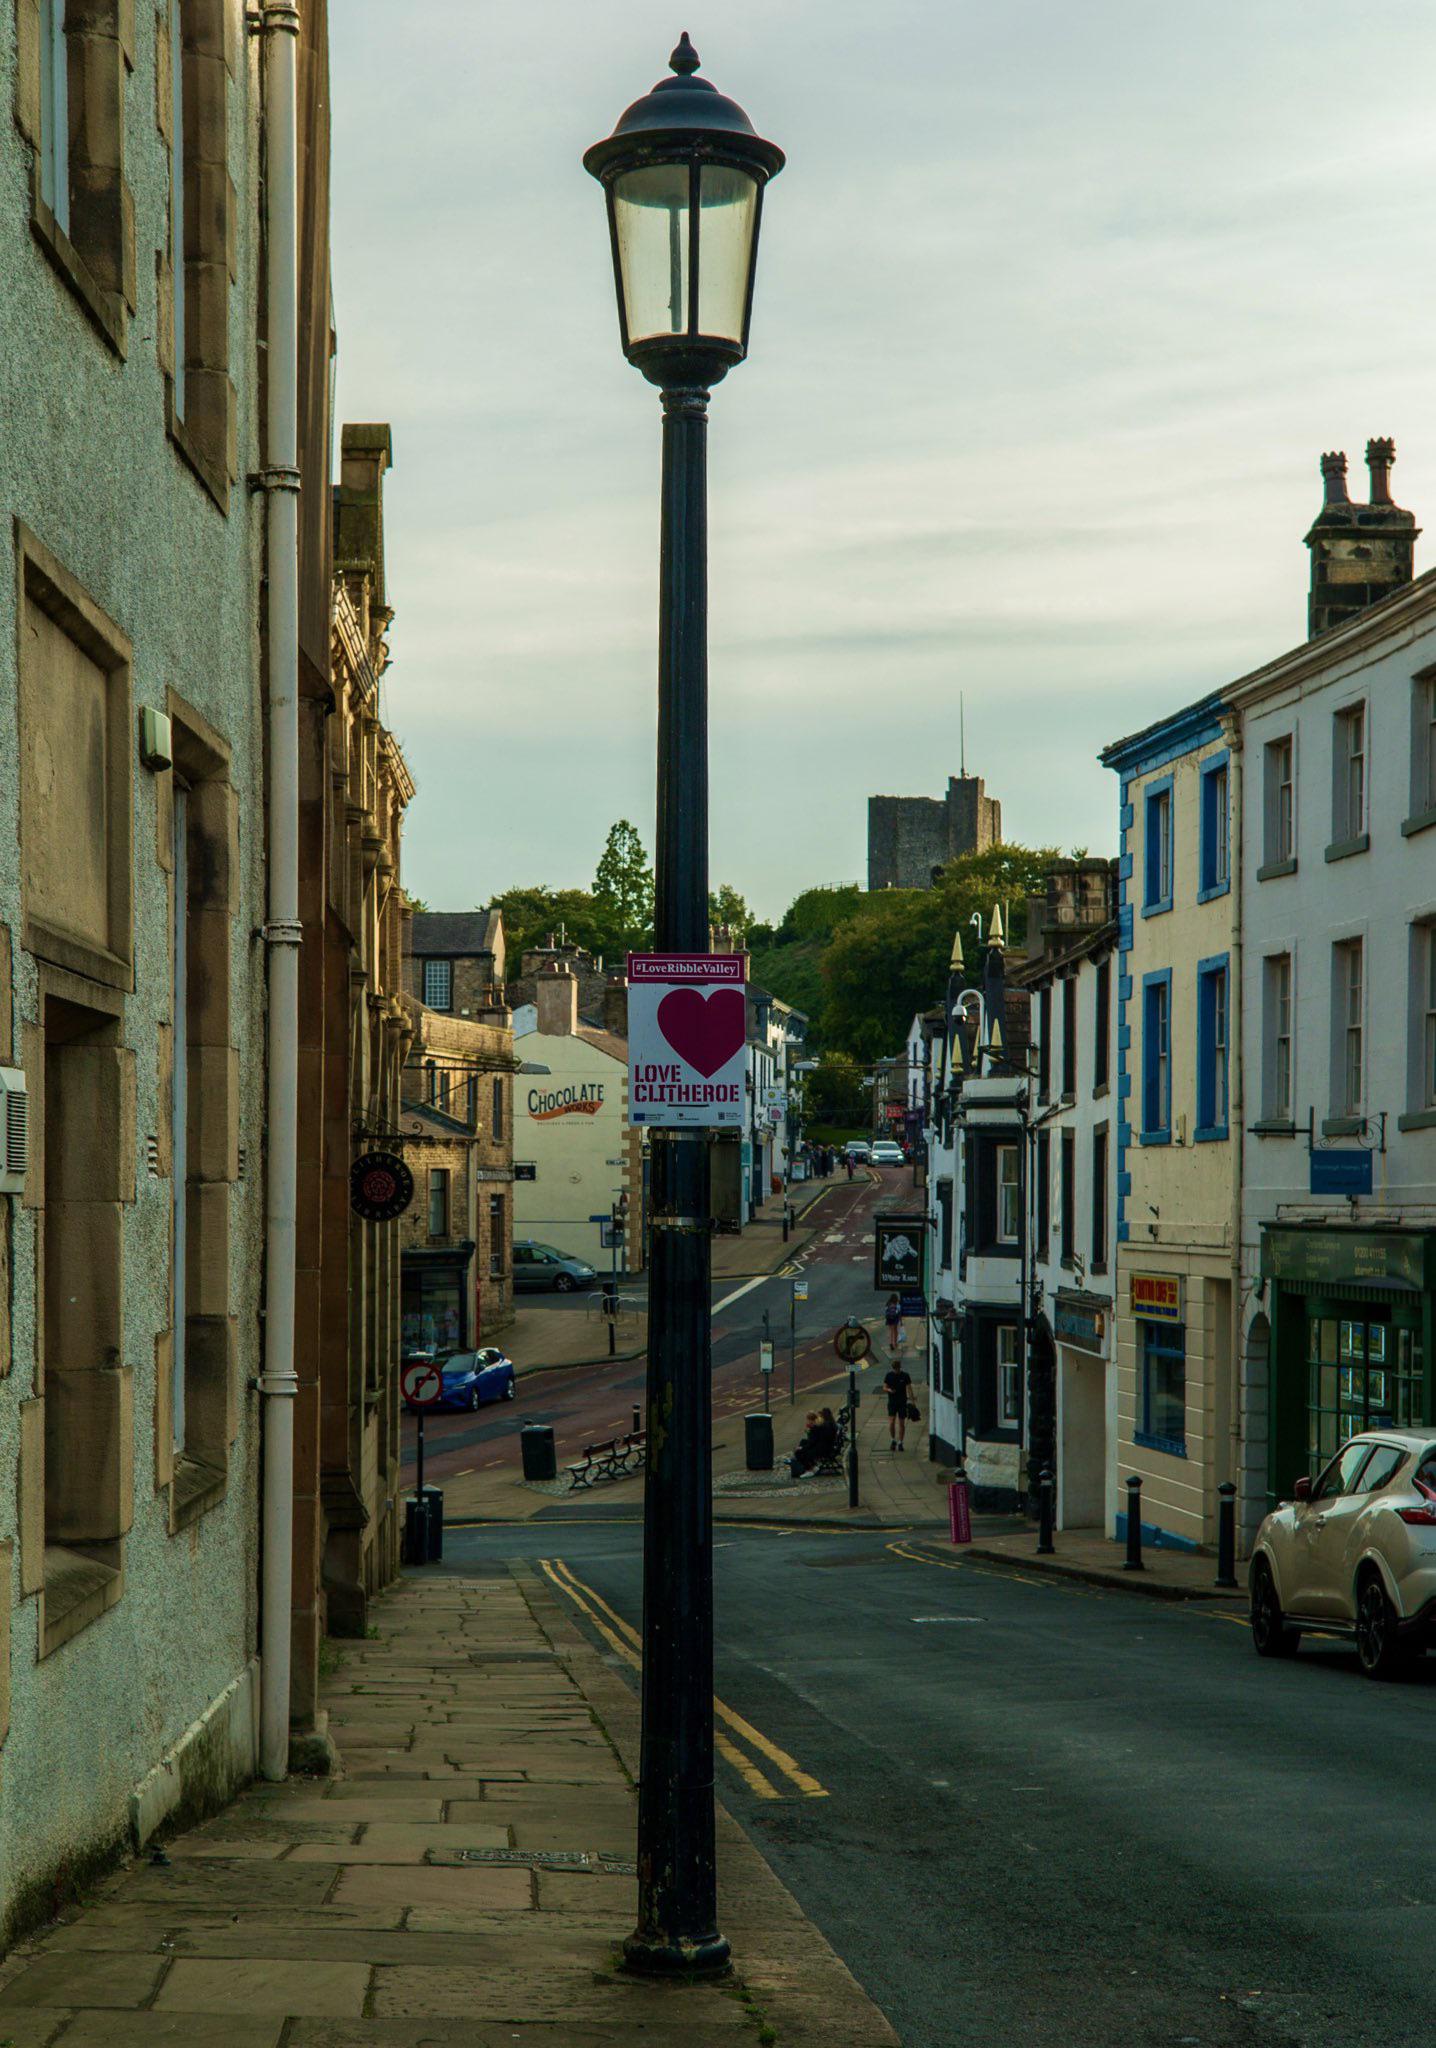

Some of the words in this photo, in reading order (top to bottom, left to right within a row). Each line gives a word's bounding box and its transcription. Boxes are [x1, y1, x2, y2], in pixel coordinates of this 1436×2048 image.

[635, 963, 737, 976] #LoveRibbleValley
[634, 1064, 681, 1083] LOVE
[528, 1083, 604, 1114] CHOCOLATE
[634, 1084, 740, 1103] CLITHEROE
[564, 1102, 596, 1114] WORKS
